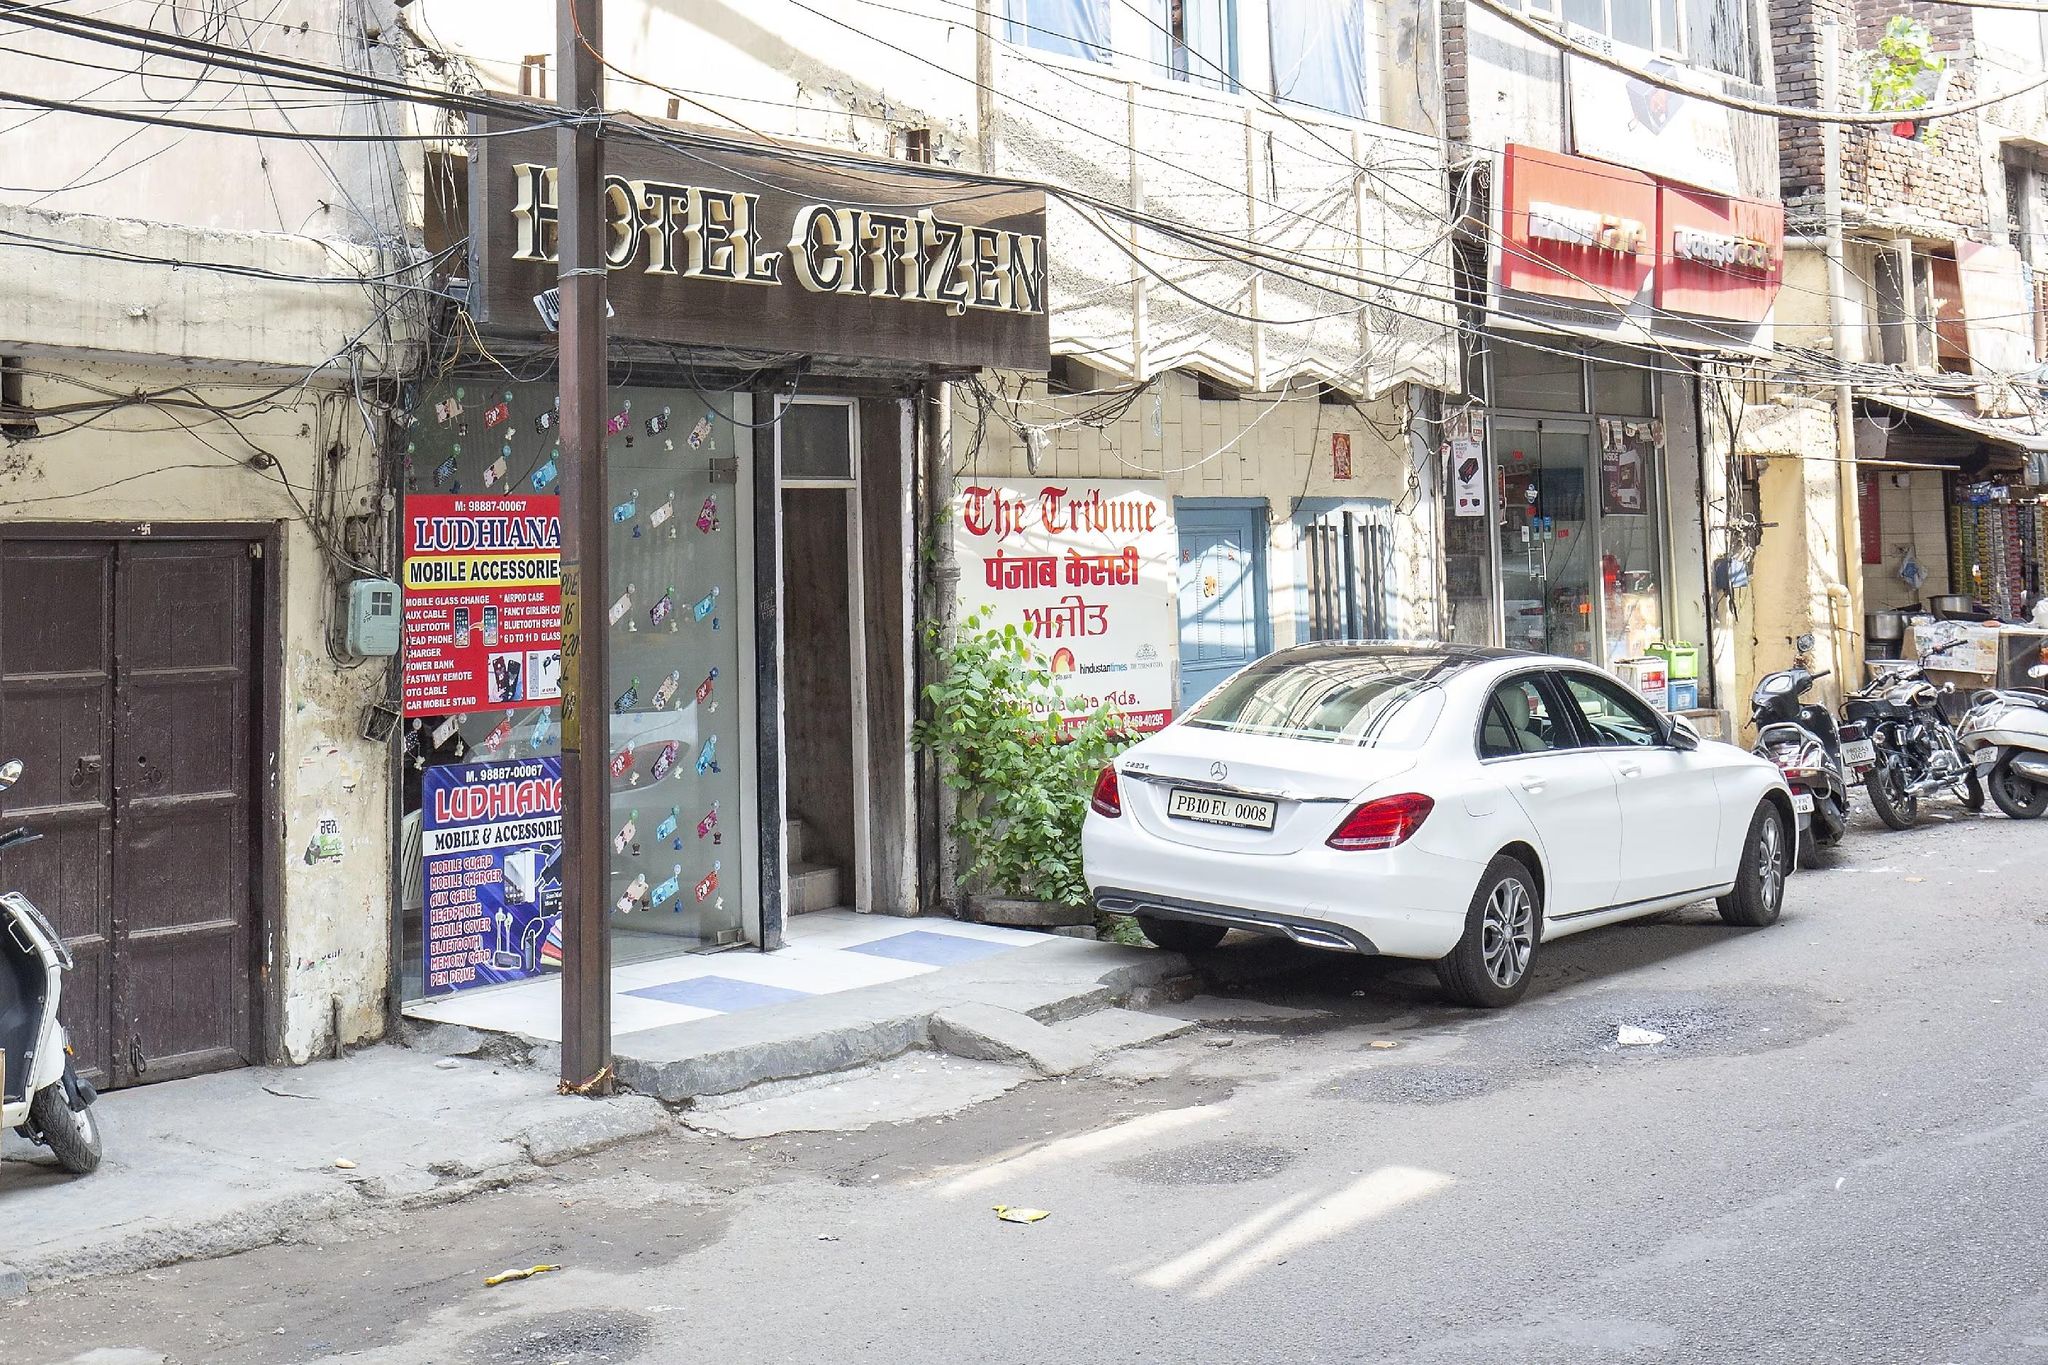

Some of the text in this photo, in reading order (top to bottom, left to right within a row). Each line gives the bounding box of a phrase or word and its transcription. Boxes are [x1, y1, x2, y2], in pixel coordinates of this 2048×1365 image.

[511, 163, 1045, 317] HOTEL CITIZEN
[455, 501, 527, 512] M: 98887-00067
[962, 486, 1157, 543] The Tribune
[413, 516, 560, 551] LUDHIANA
[410, 559, 560, 583] MOBILE ACCESSORIE
[983, 545, 1141, 590] पंजाब केसरी
[406, 595, 490, 607] MOBILE GLASS CHANGE
[504, 592, 544, 603] AIRPOD CASE
[405, 609, 447, 620] AUX CABLE
[504, 606, 525, 616] FANCY
[526, 605, 550, 615] GIRLISH
[1023, 595, 1109, 639] ਅਜੀਤ
[406, 622, 450, 632] BLUETOOTH
[504, 619, 541, 630] BLUETOOTH
[406, 635, 453, 645] HEAD PHONE
[406, 660, 455, 671] POWER BANK
[406, 671, 473, 684] FASTWAY REMOTE
[406, 686, 447, 697] OTG CABLE
[406, 696, 477, 710] CAR MOBILE STAND
[466, 764, 543, 782] M. 98887-00067
[1176, 795, 1210, 814] PB10
[1235, 803, 1267, 821] 0008
[435, 829, 479, 851] MOBILE
[482, 828, 492, 845] &
[430, 855, 493, 875] MOBILE GUARD
[430, 869, 502, 891] MOBILE CHARGER
[430, 887, 476, 908] AUX CABLE
[430, 903, 482, 924] HEADPHONE
[431, 918, 491, 940] MOBILE COVER
[431, 935, 480, 955] BLUETOOTH
[431, 949, 491, 971] MEMORY CARD
[431, 967, 475, 987] PEN DRIVE
